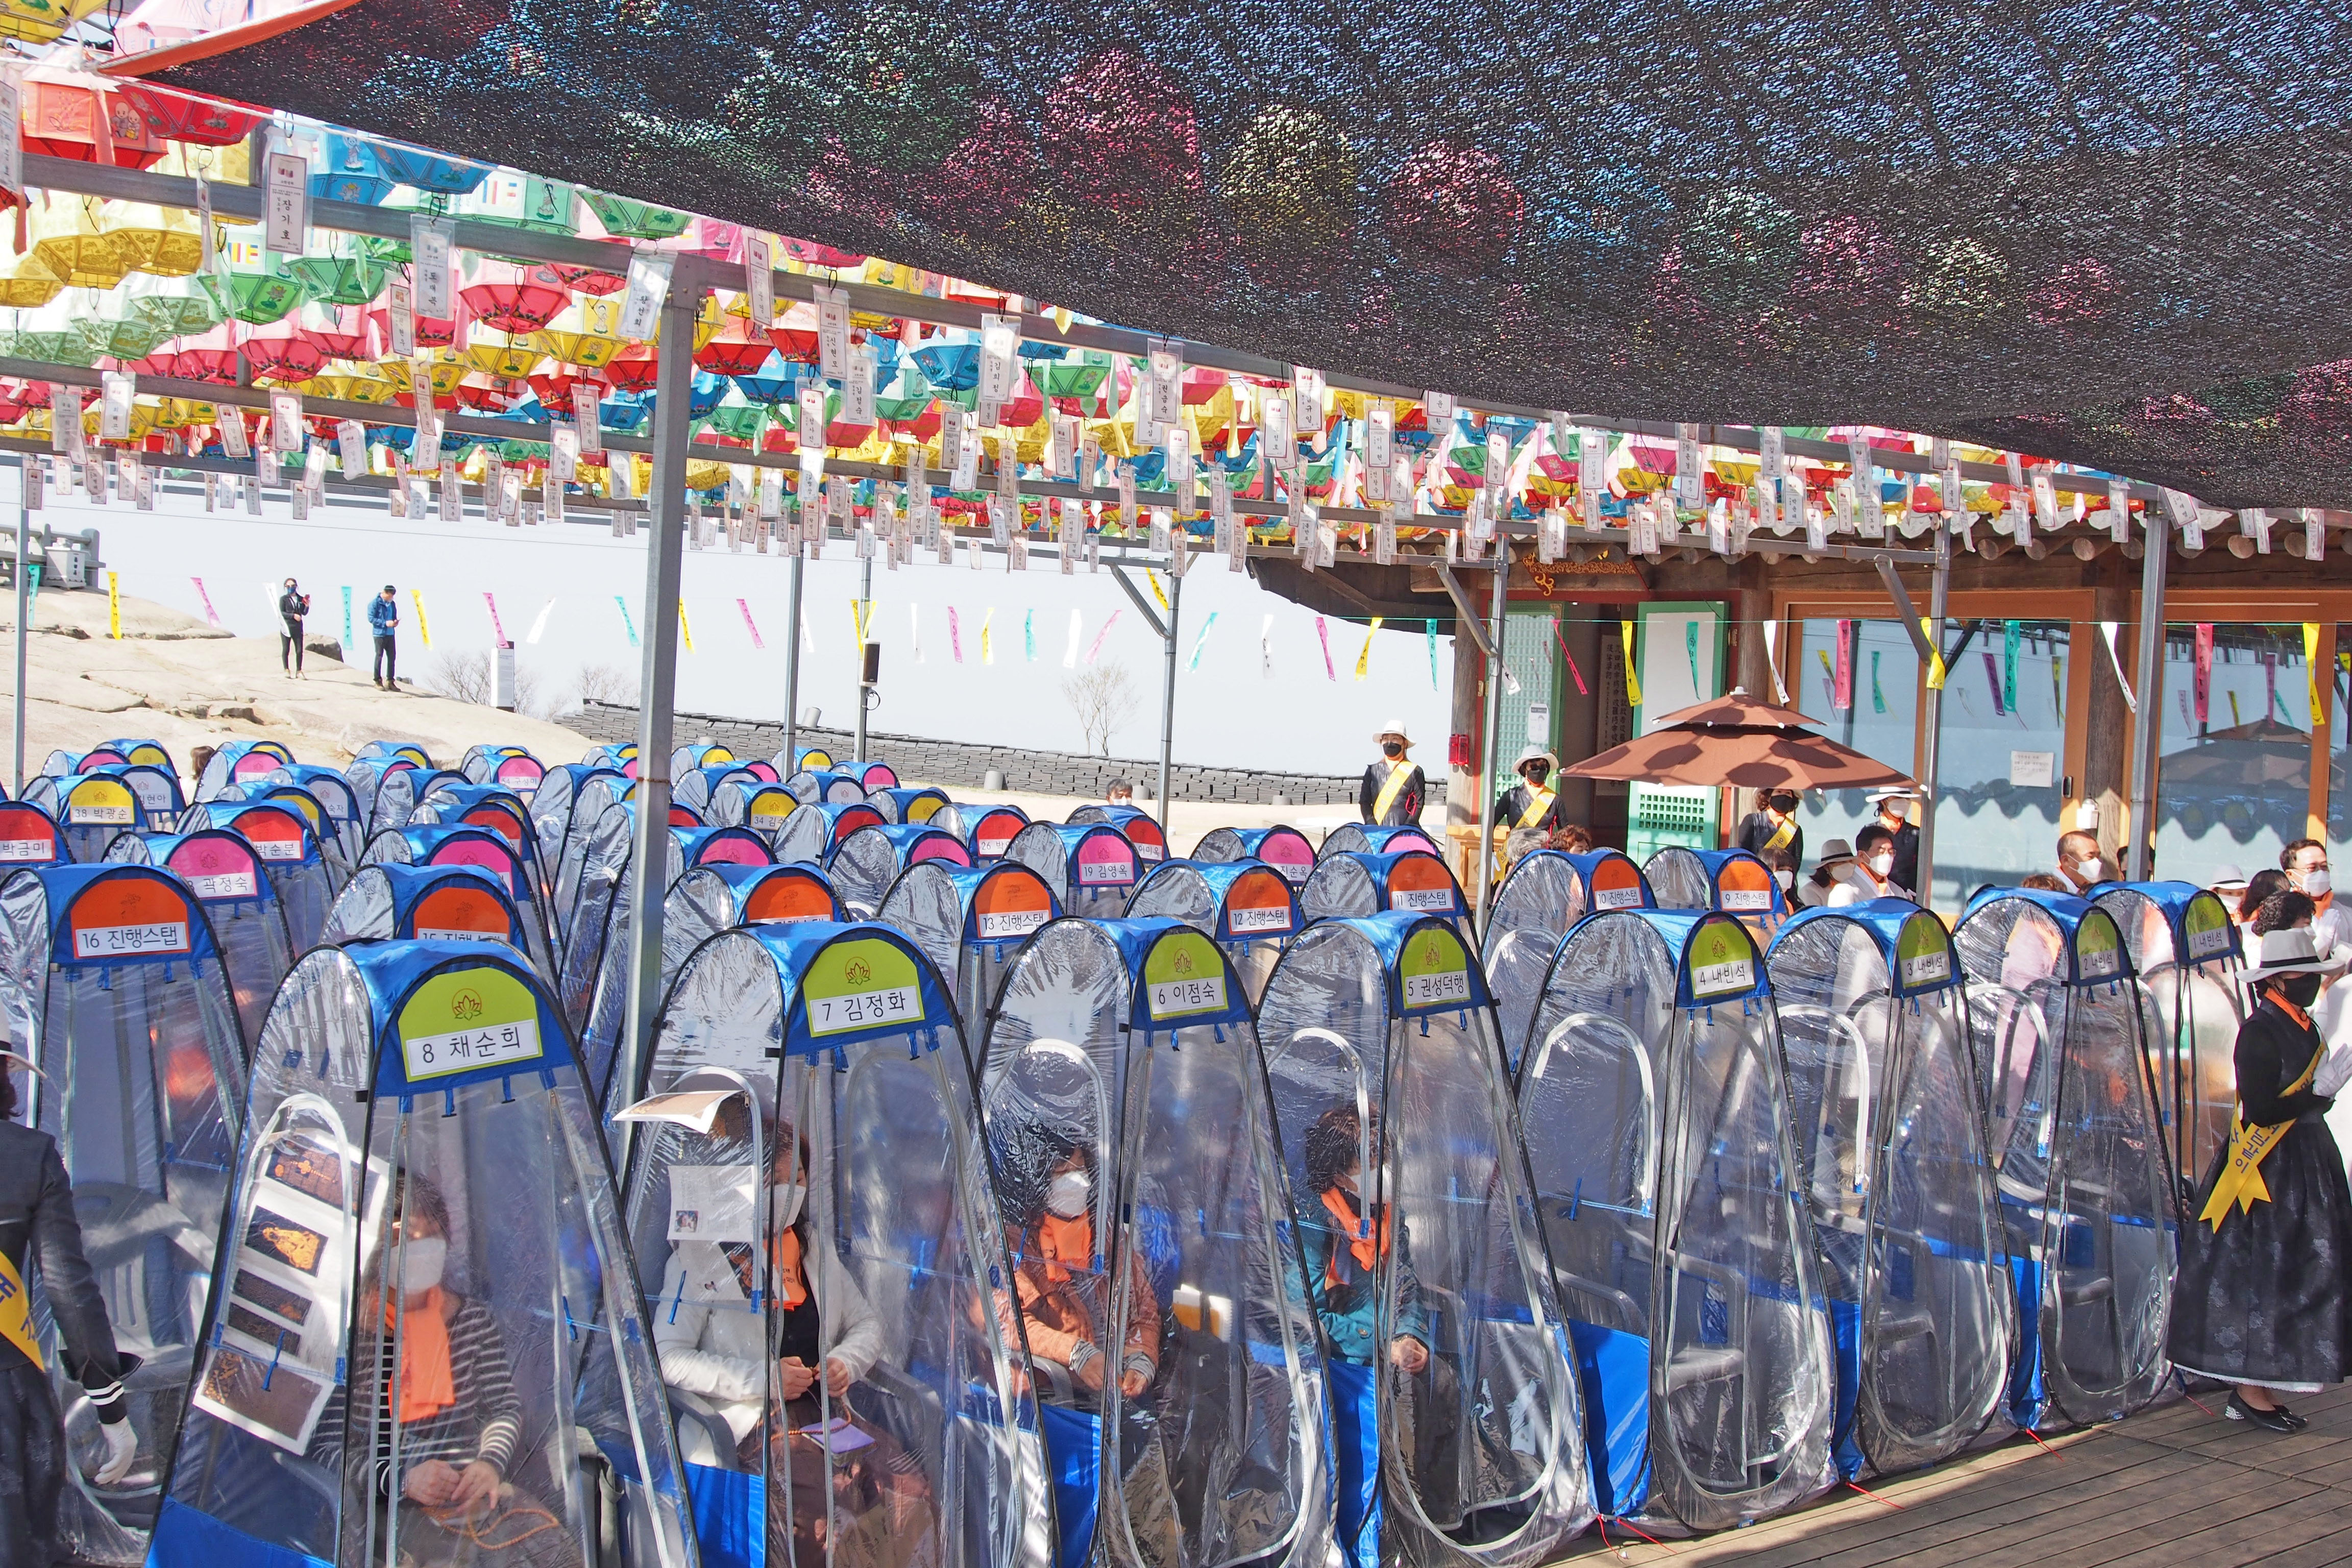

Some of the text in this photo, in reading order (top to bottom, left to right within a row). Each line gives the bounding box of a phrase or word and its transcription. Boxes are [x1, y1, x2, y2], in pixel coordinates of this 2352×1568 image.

[75, 808, 128, 820] 38 박광순
[324, 804, 345, 813] 숙자
[754, 816, 764, 825] 34
[3, 842, 44, 856] 박금미
[255, 843, 295, 856] 박순분
[981, 841, 991, 851] 26
[1138, 845, 1160, 857] 이미옥
[1084, 865, 1128, 879] 19 김영옥
[204, 876, 248, 892] 곽정숙
[1396, 891, 1447, 908] 11 진행스탭
[1598, 890, 1639, 905] 10 진행스탭
[1725, 892, 1766, 906] 9 진행스탭
[983, 914, 1045, 933] 13 진행스탭
[1234, 909, 1285, 926] 12 진행스탭
[82, 925, 178, 949] 16 진행스탭
[2199, 932, 2223, 947] 내빈석
[1907, 956, 1945, 976] 3 내빈석
[2084, 953, 2113, 969] 2 내빈석
[1699, 963, 1746, 986] 4 내빈석
[1158, 982, 1216, 1006] 6 이점숙
[1408, 975, 1465, 998] 5 권성덕행
[821, 990, 907, 1022] 7 김정화
[421, 1026, 522, 1064] 8 채순희
